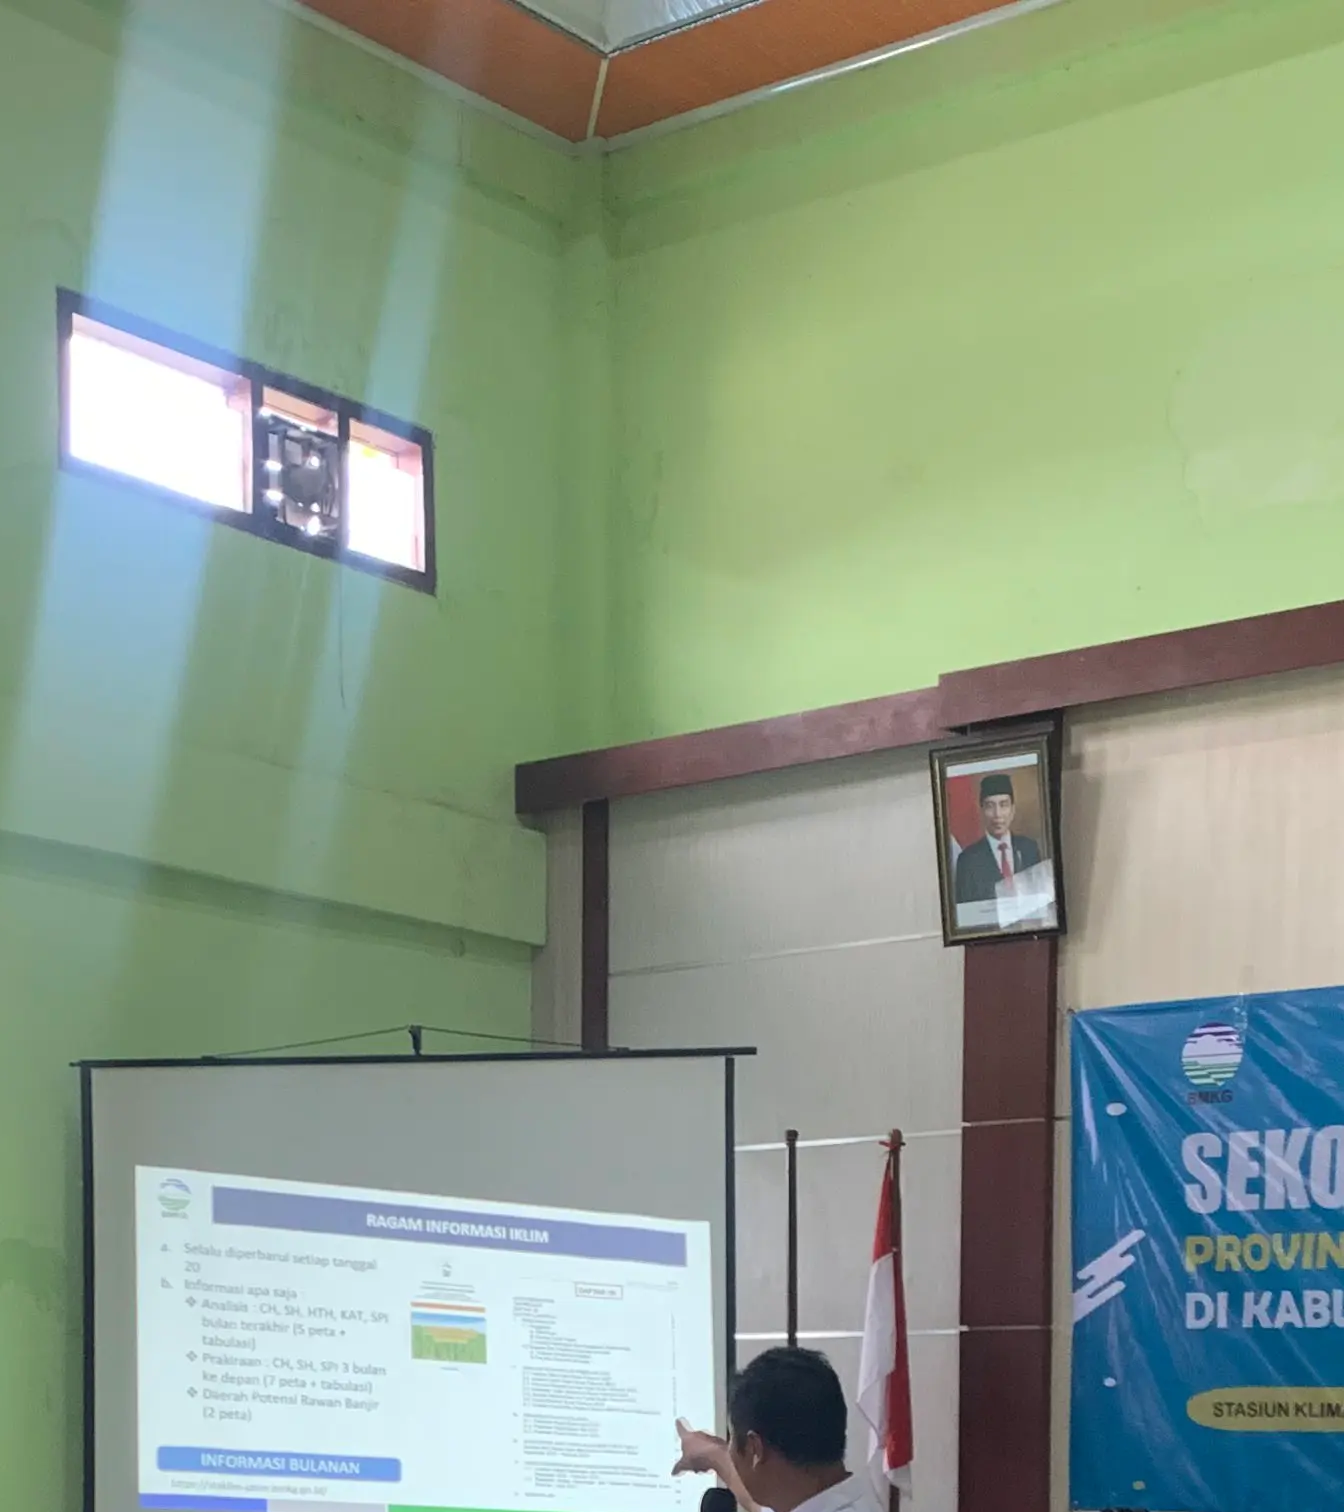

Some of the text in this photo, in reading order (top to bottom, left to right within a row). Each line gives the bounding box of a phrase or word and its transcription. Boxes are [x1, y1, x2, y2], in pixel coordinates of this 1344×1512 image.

[366, 1213, 549, 1243] RAGAM INFORMASI IKLIM
[183, 1242, 222, 1257] Selalu
[292, 1254, 330, 1268] setiap
[333, 1257, 377, 1272] tanggal
[184, 1260, 201, 1273] 20
[184, 1278, 244, 1295] Informasi
[247, 1286, 270, 1299] apa
[1185, 1291, 1230, 1330] DI
[201, 1316, 237, 1330] bulan
[240, 1320, 289, 1333] terakhir
[308, 1326, 336, 1338] peta
[202, 1335, 256, 1351] tabulasi)
[202, 1352, 262, 1367] Prakiraan
[272, 1357, 294, 1370] CH,
[342, 1362, 349, 1373] 3
[353, 1360, 387, 1376] bulan
[202, 1370, 218, 1382] ke
[221, 1372, 260, 1386] depan
[263, 1374, 276, 1388] (7
[279, 1377, 307, 1388] peta
[320, 1380, 373, 1395] tabulasi)
[202, 1388, 380, 1412] Daerah Potensi Rawan Banjir
[1212, 1401, 1290, 1418] STASIUN
[202, 1406, 253, 1423] (2 peta)
[200, 1453, 361, 1475] INFORMASI BULANAN
